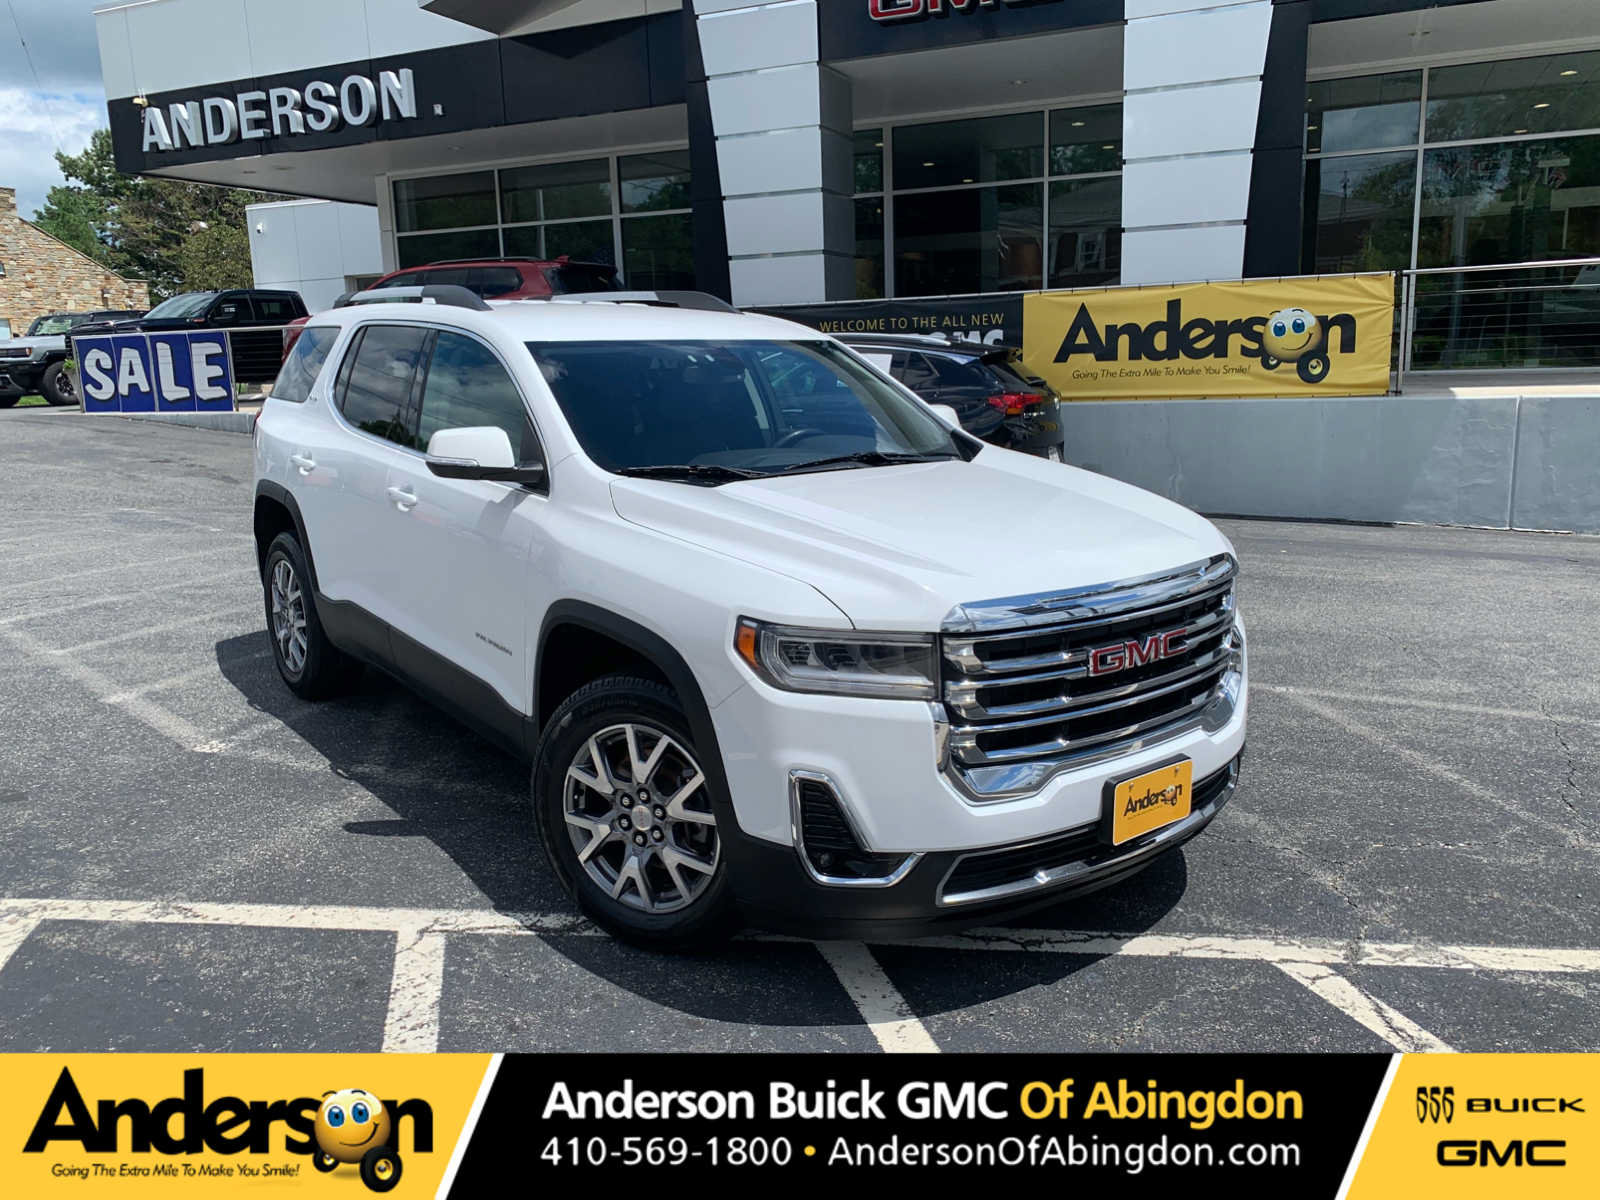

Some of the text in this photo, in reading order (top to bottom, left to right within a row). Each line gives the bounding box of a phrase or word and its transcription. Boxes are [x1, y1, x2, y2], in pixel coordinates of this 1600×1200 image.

[142, 68, 417, 152] ANDERSON
[820, 312, 1004, 332] WELCOME TO THE ALL NEW
[1053, 298, 1357, 364] Andersn
[84, 342, 228, 401] SALE
[1072, 364, 1251, 381] Going The Extra Mile To Make You Smile!
[1088, 627, 1188, 677] GMC
[1123, 783, 1183, 816] Andersn
